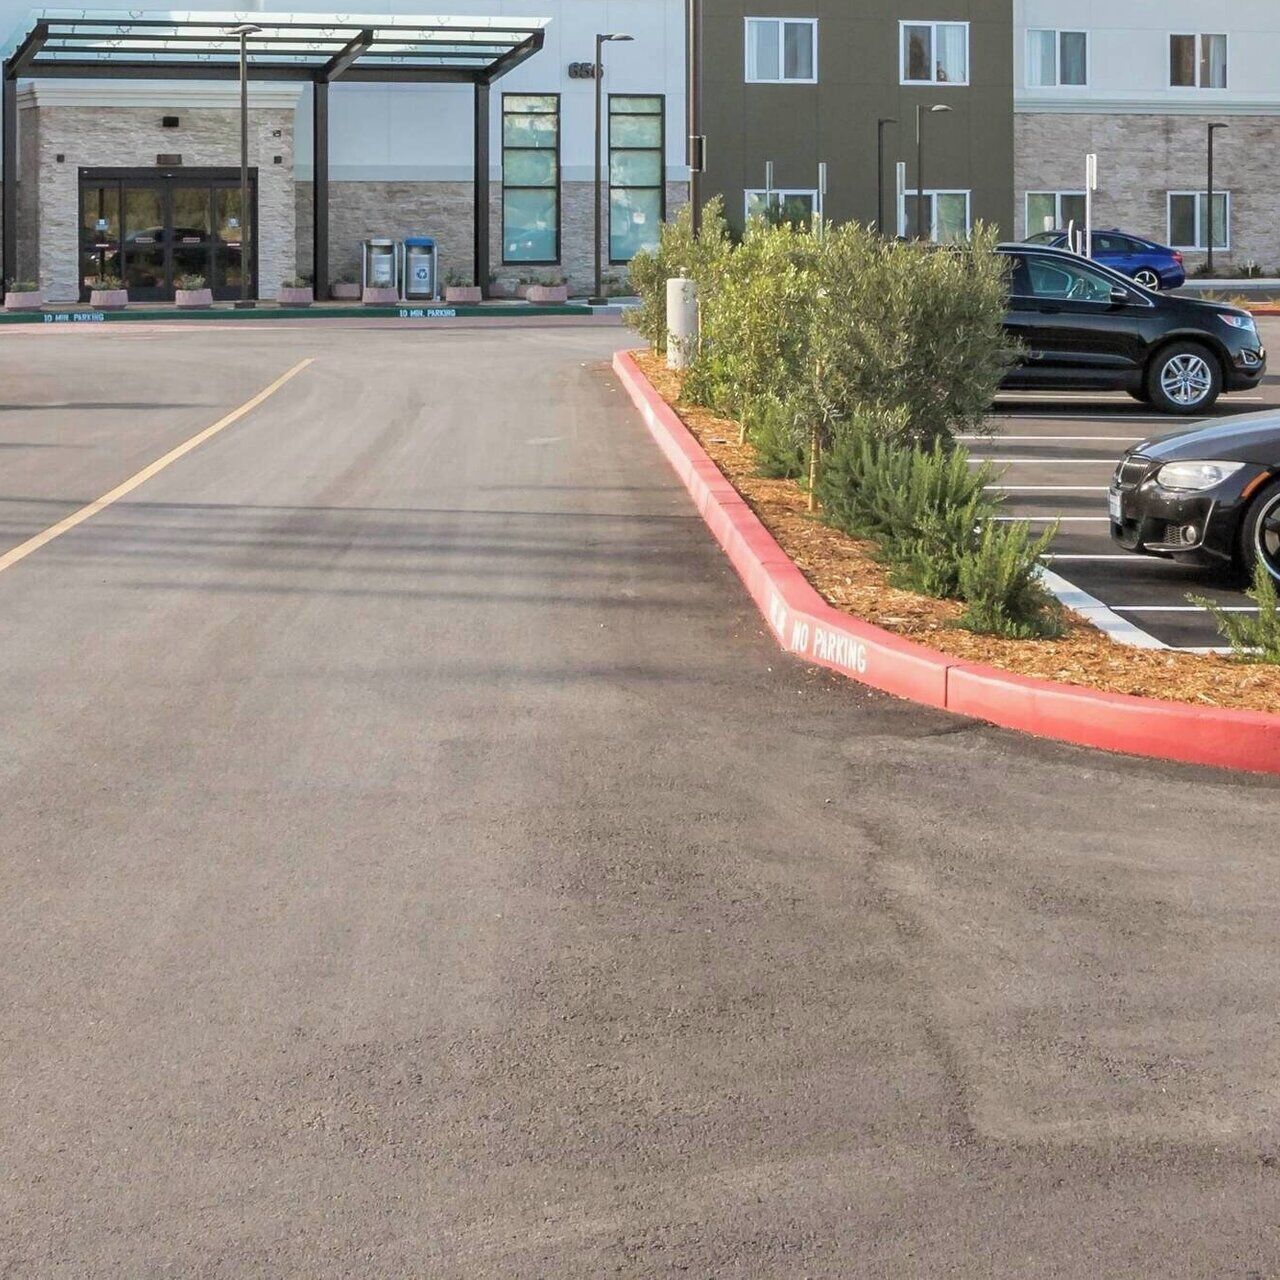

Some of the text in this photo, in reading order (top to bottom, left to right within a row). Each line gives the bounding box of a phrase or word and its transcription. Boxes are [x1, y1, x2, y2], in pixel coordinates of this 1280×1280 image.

[73, 313, 104, 322] PARKING
[428, 309, 456, 317] PARKING
[791, 620, 867, 674] NO PARKING
